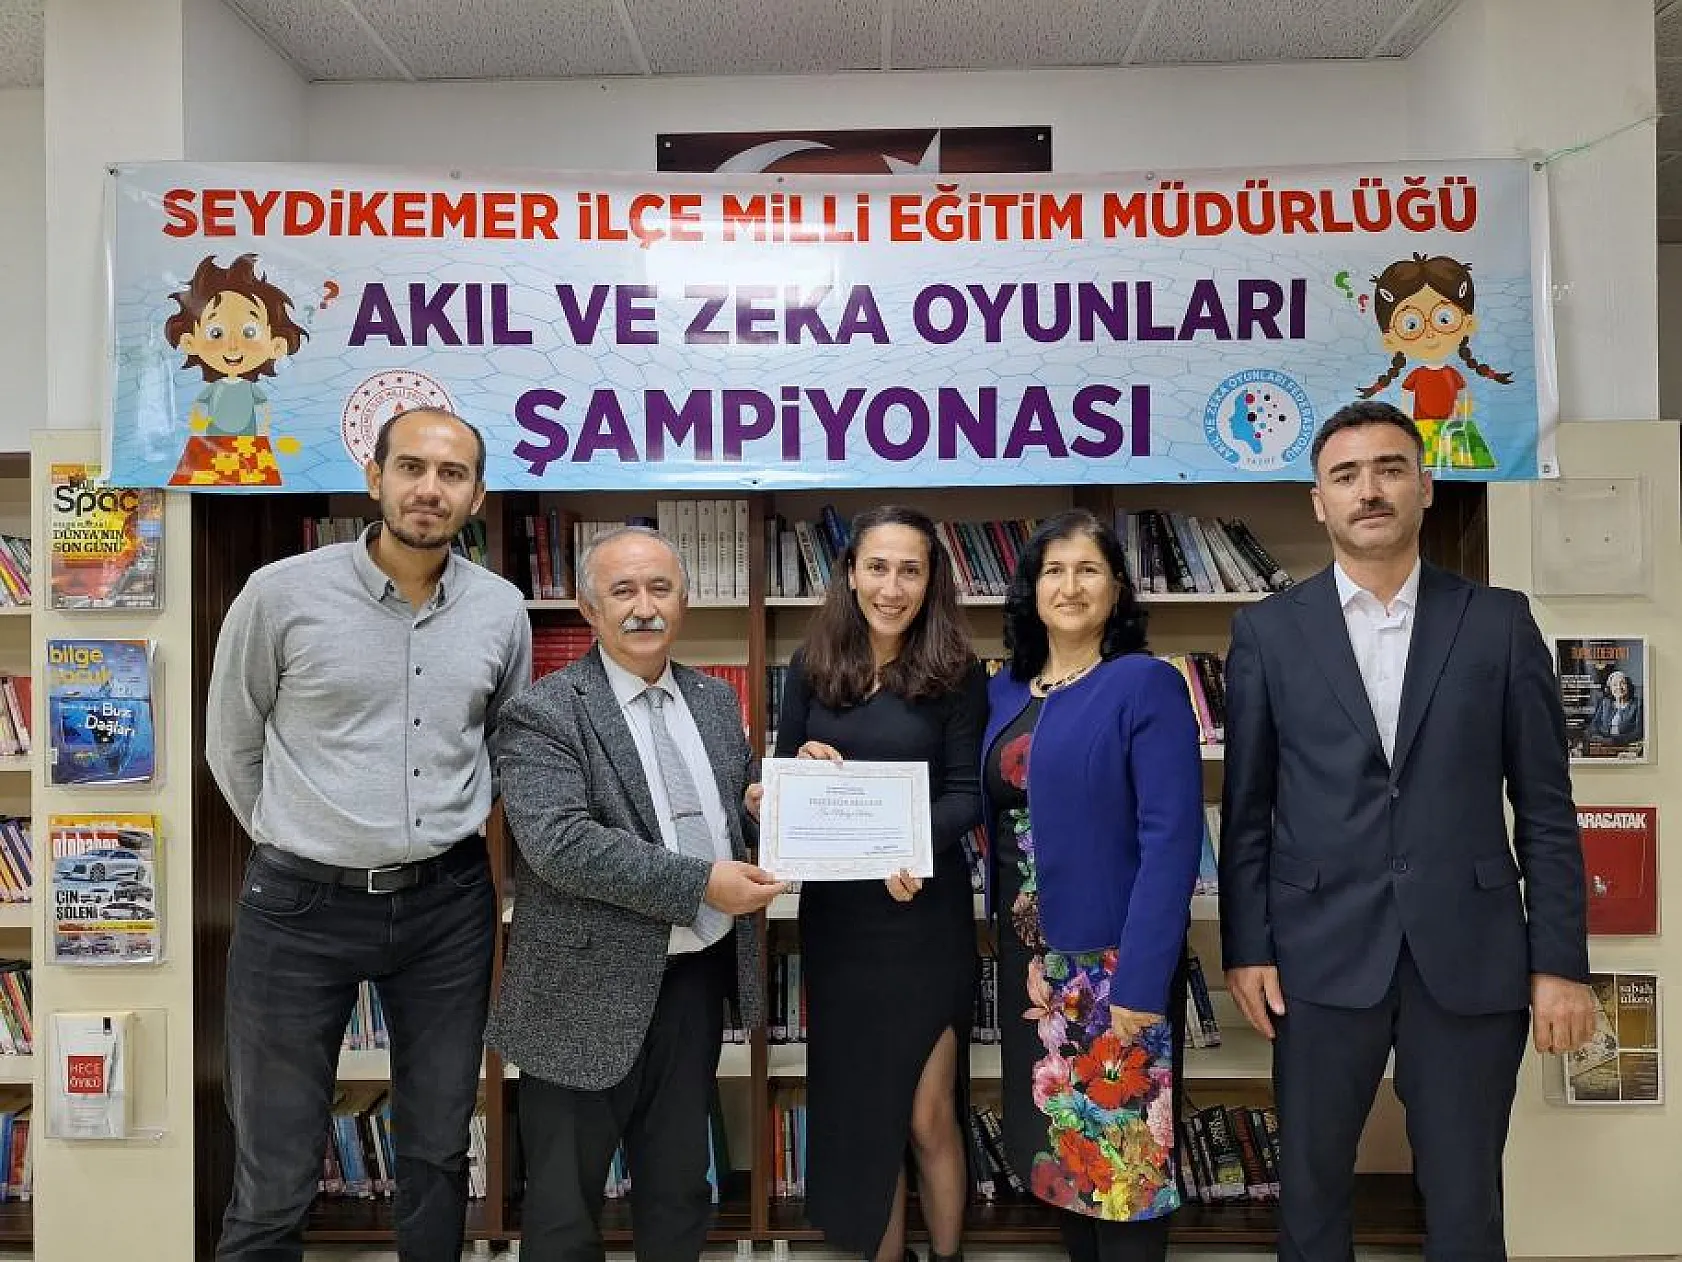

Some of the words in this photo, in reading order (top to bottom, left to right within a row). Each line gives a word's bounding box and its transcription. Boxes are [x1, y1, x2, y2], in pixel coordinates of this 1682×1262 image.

[1103, 176, 1477, 238] MÜDÜRLÜĞÜ
[348, 282, 533, 347] AKIL
[556, 283, 659, 345] VE
[684, 283, 890, 345] ZEKA
[912, 278, 1307, 345] OYUNLARI
[49, 643, 104, 668] bilge
